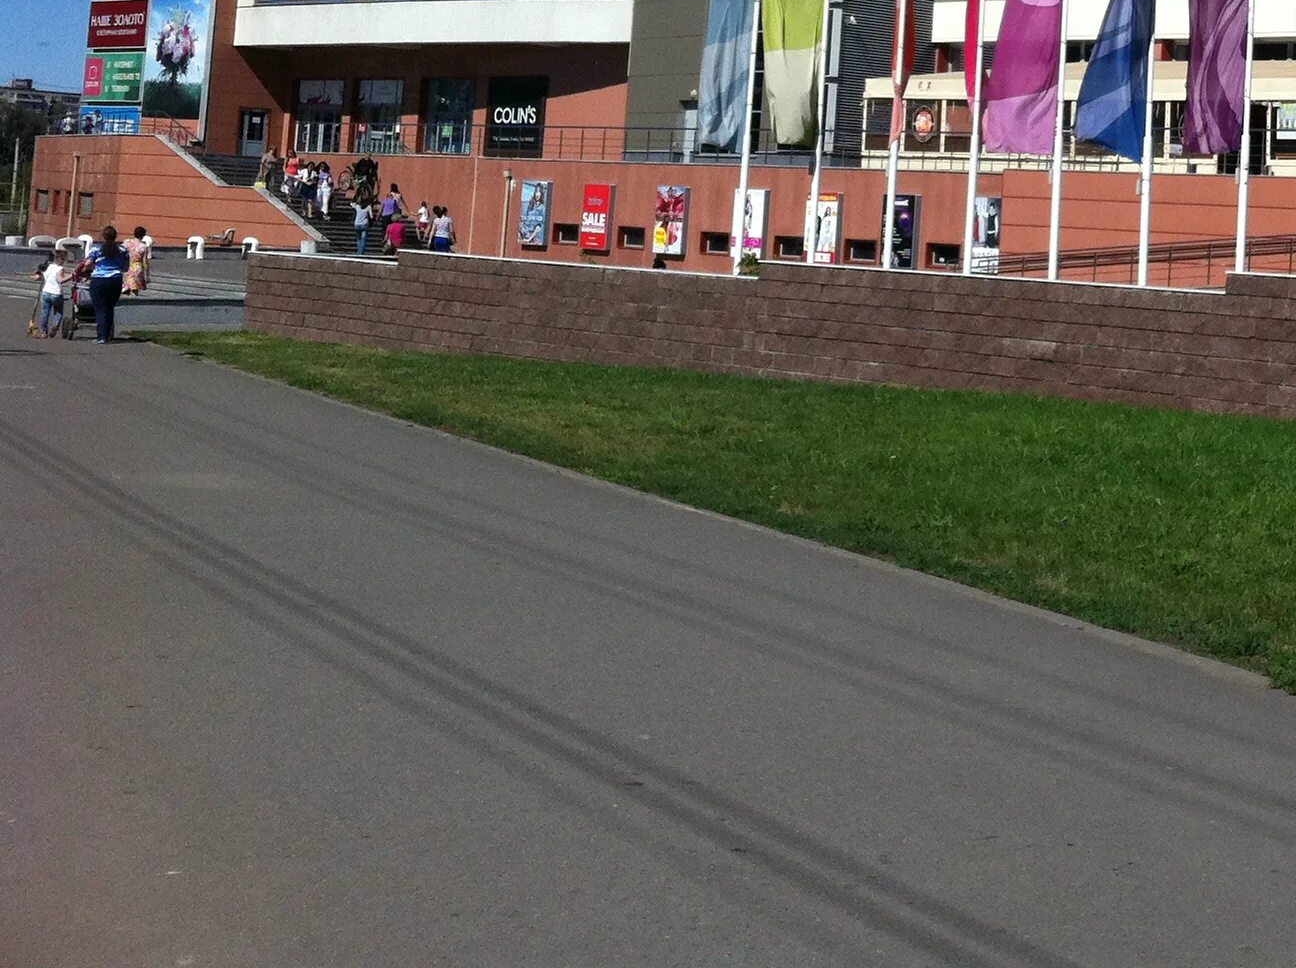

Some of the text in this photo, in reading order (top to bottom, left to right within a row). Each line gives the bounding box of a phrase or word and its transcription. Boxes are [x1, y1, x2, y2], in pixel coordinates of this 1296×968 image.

[91, 13, 144, 26] НАШЕ ЗОЛОТО
[494, 105, 536, 124] COLIN'S
[582, 212, 606, 227] SALE
